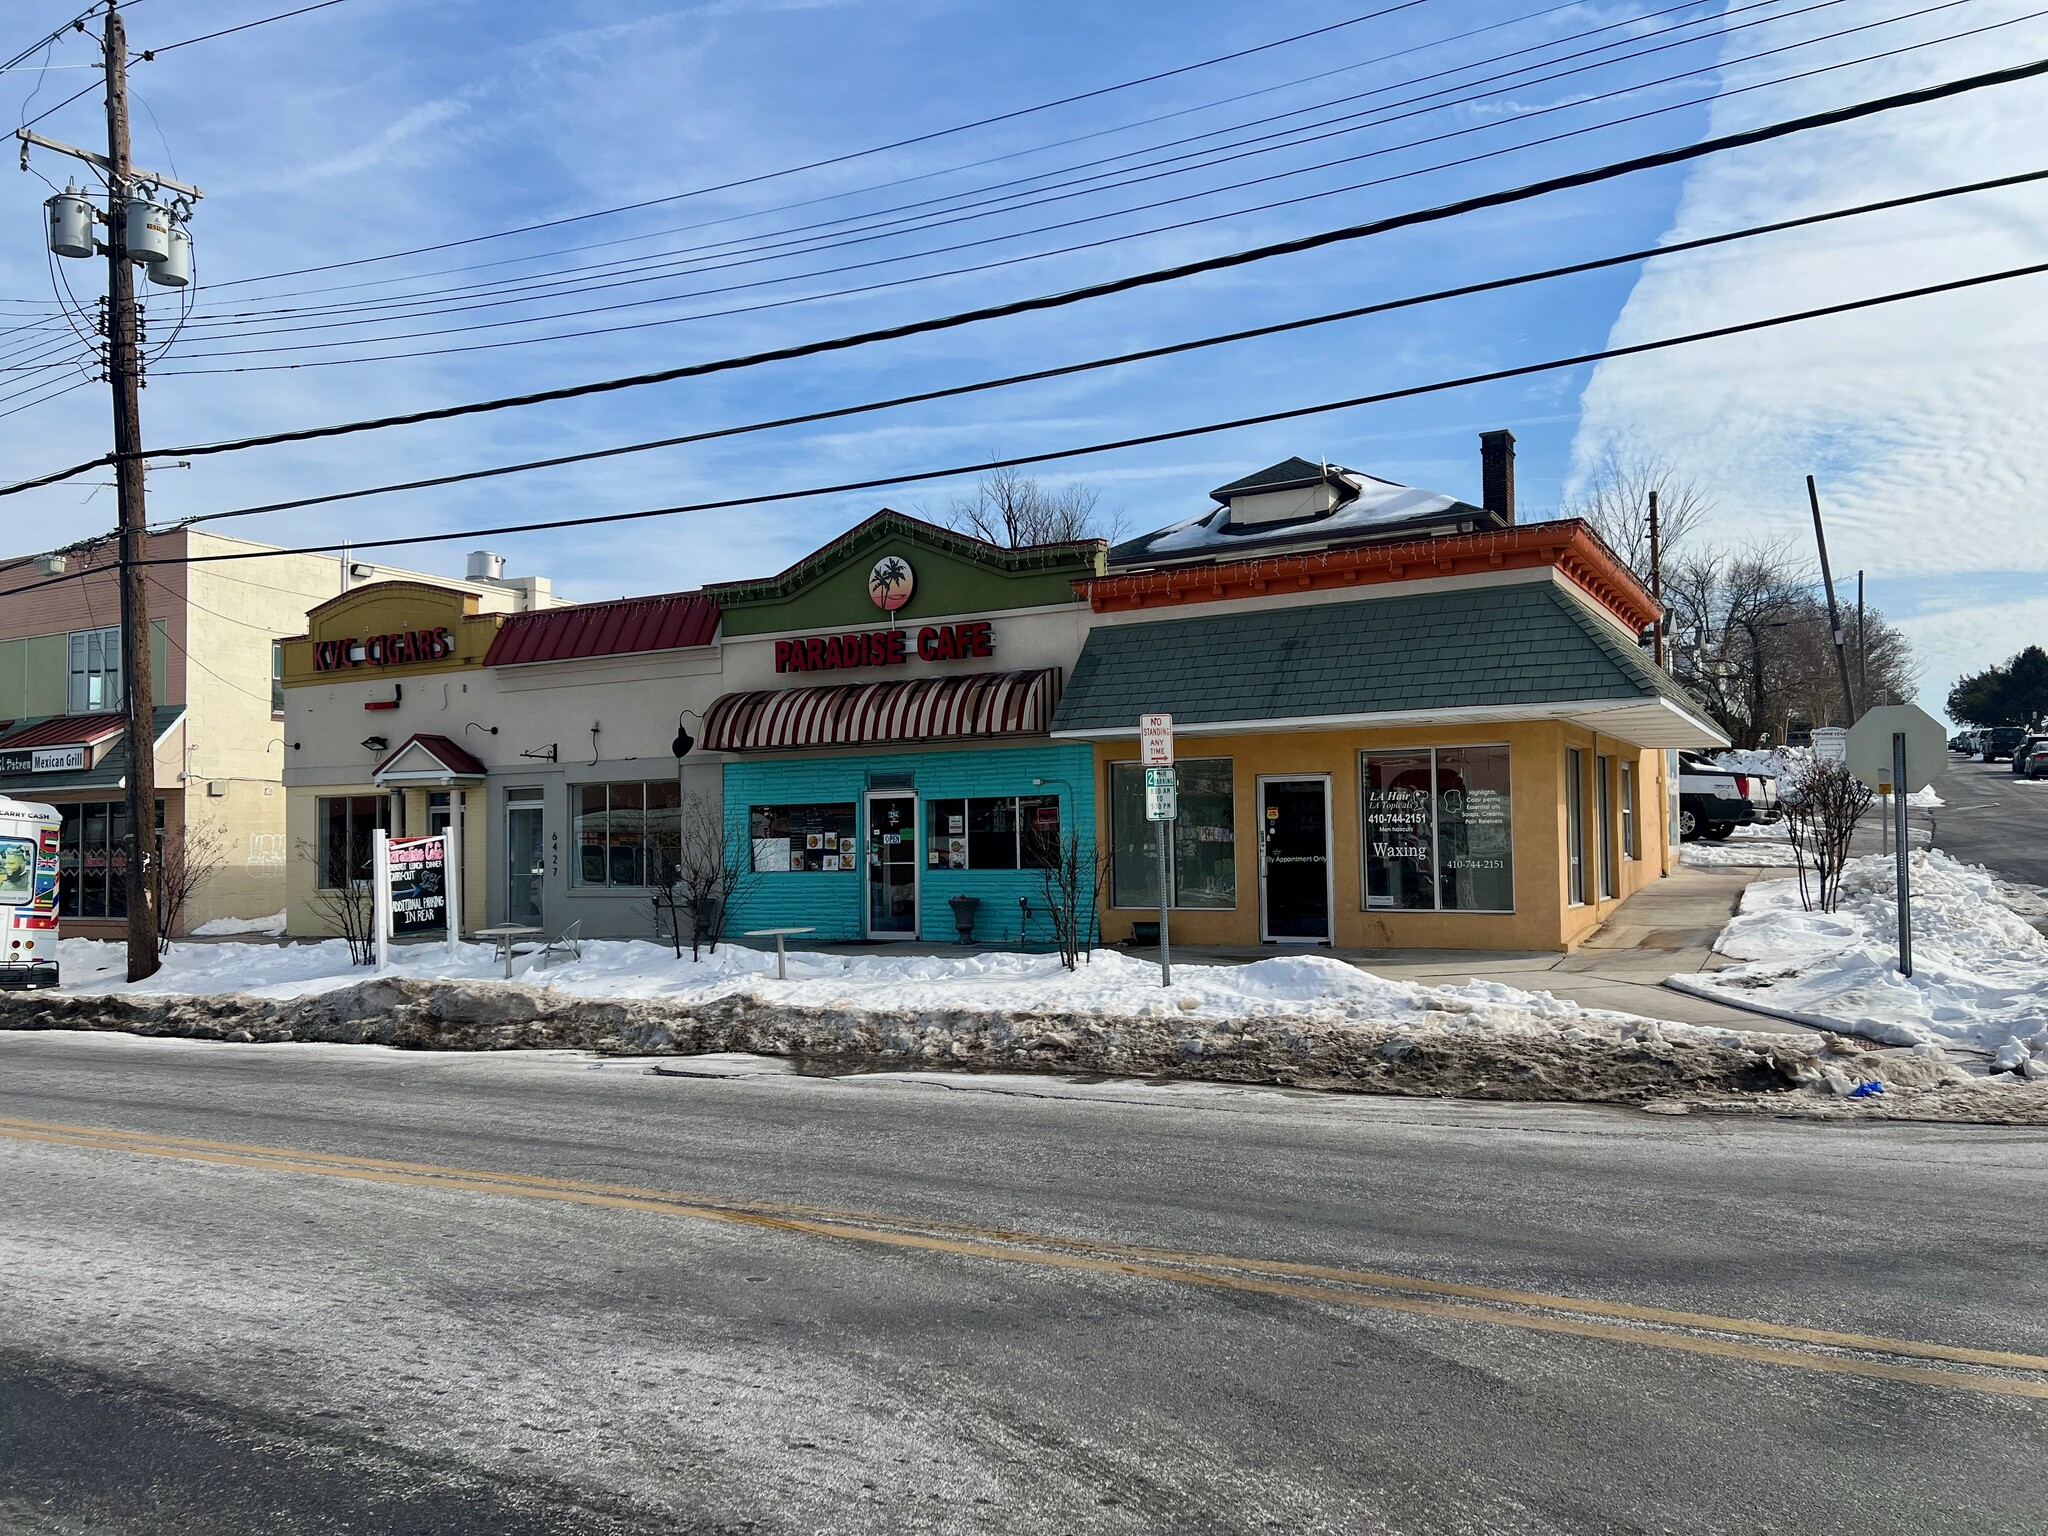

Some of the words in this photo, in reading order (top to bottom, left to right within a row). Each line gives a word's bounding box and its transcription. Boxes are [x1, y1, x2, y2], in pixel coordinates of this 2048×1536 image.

[313, 638, 357, 671] KVC
[365, 626, 449, 666] CIGARS
[775, 630, 907, 673] PARADISE
[917, 622, 993, 661] CAFE
[1151, 717, 1162, 726] NO
[1144, 728, 1170, 736] STANDING
[34, 755, 64, 769] Mexican
[66, 752, 82, 767] Grill
[1148, 772, 1154, 784] 2
[1369, 791, 1384, 801] LA
[1387, 791, 1411, 801] Hair
[1382, 801, 1413, 811] Topicals
[1368, 813, 1426, 824] 410-744-2151
[885, 835, 900, 843] OPEN
[1373, 842, 1427, 860] Waxing
[1276, 856, 1313, 864] Appointment
[1313, 855, 1328, 864] Only
[1447, 860, 1505, 869] 410-744-2151
[426, 861, 442, 869] DINNER
[423, 896, 444, 909] PARKING
[404, 911, 416, 923] IN
[417, 909, 435, 922] REAR
